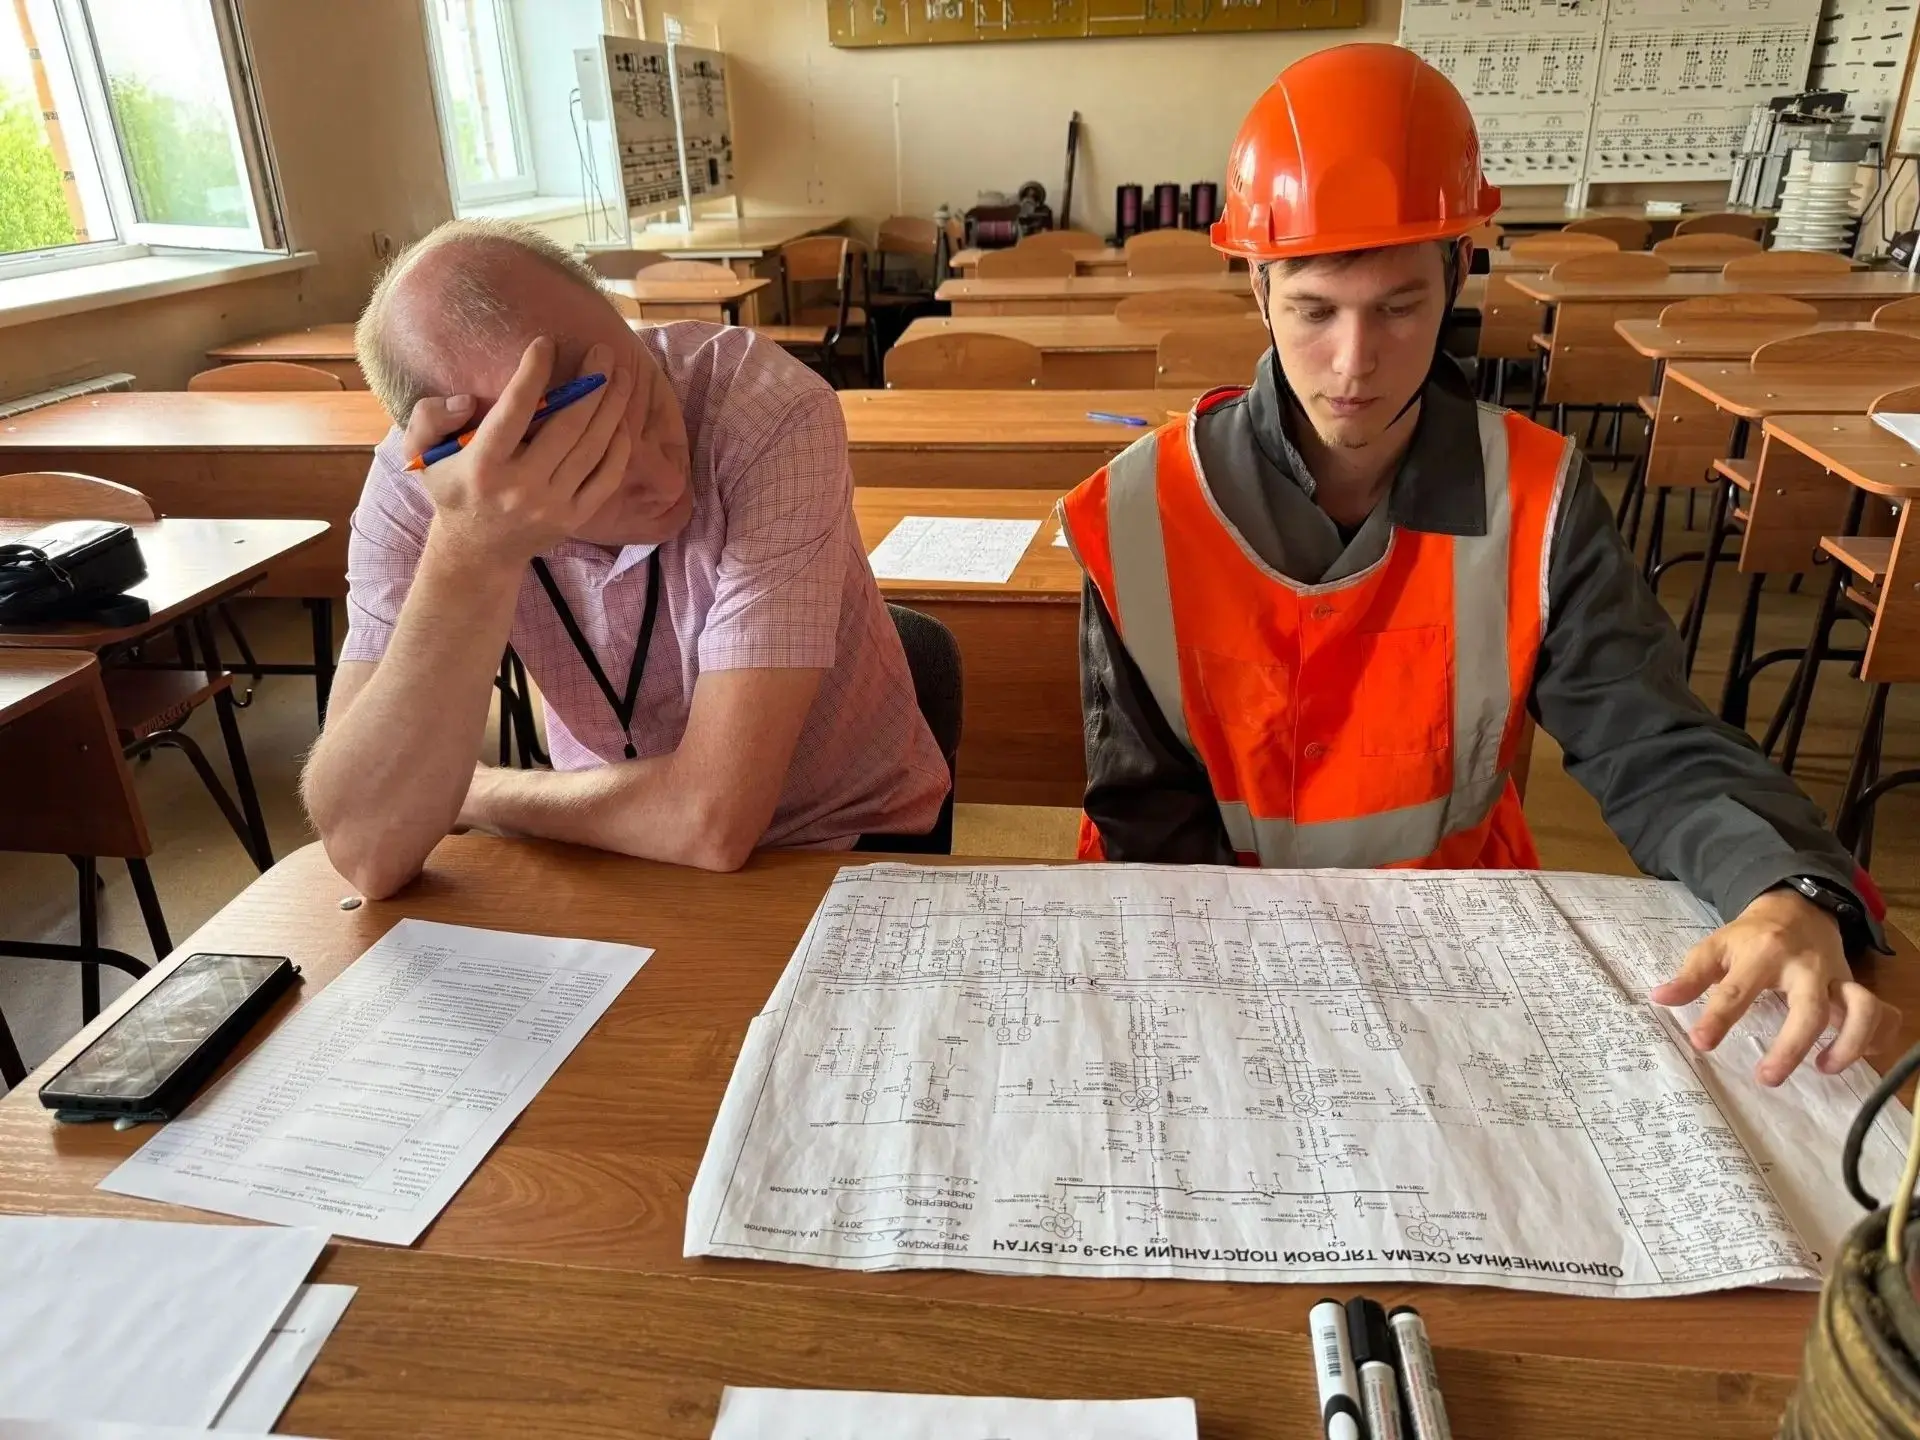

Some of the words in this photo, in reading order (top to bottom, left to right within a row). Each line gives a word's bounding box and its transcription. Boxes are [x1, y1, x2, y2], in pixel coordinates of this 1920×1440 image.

[838, 1178, 861, 1186] 2017
[838, 1220, 864, 1230] 2017
[992, 1239, 1078, 1255] ст.БУГАЧ
[1083, 1244, 1139, 1257] ЭЧЭ-9
[1144, 1245, 1278, 1263] ПОДСТАНЦИИ
[1284, 1250, 1378, 1266] ТЯГОВОЙ
[1383, 1249, 1452, 1265] СХЕМА
[1457, 1253, 1624, 1279] ОДНОЛИНЕЙНАЯ
